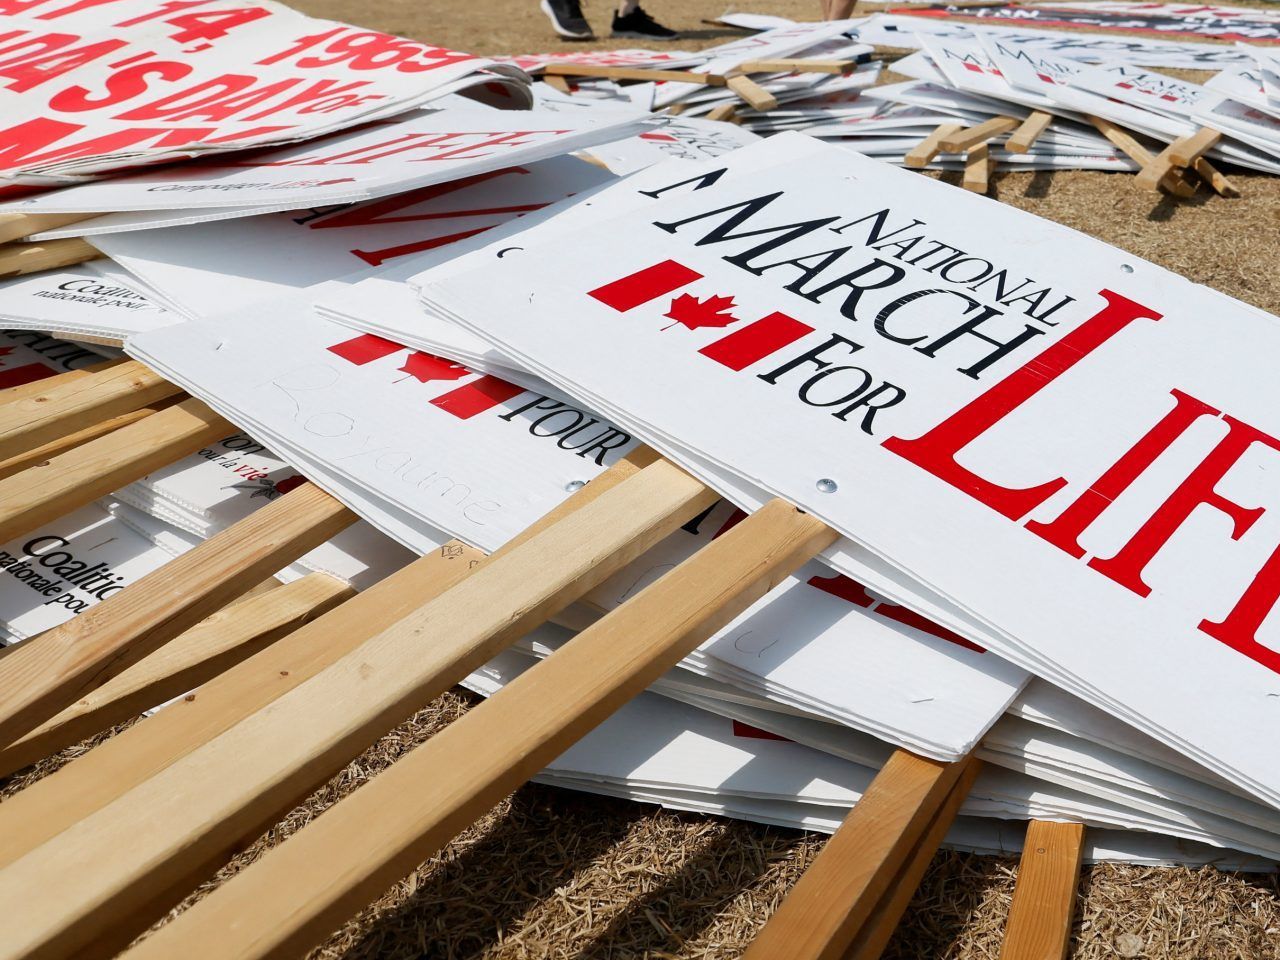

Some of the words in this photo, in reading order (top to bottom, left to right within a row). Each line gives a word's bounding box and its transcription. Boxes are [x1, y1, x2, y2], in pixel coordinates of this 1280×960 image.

[253, 26, 482, 73] 1969
[109, 73, 376, 122] DAY
[296, 93, 392, 115] OF
[652, 190, 1047, 381] MARCH
[829, 207, 1077, 327] NATIONAL
[756, 332, 907, 436] FOR
[232, 464, 269, 481] vie
